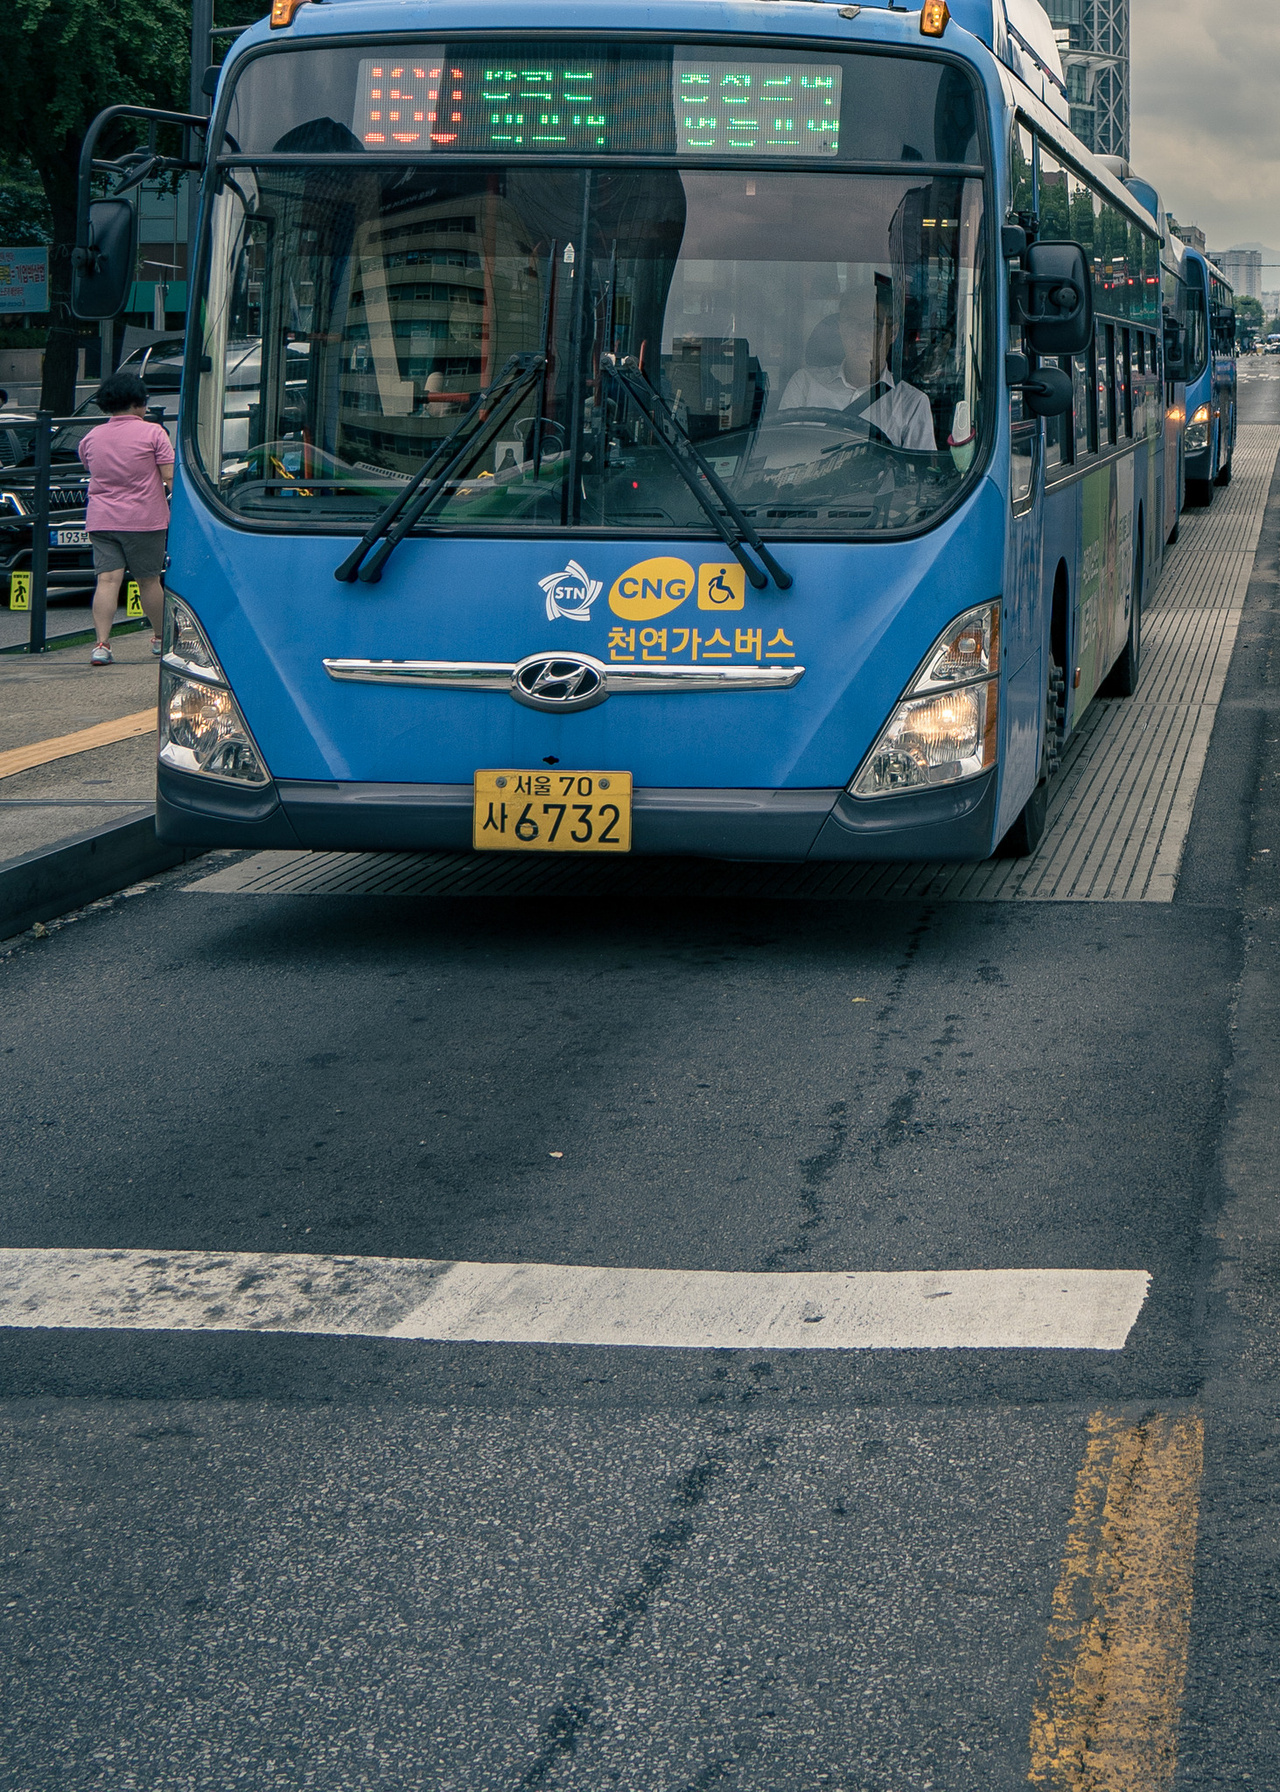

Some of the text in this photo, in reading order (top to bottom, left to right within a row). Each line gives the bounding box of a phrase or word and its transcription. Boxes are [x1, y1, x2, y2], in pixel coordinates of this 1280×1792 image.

[555, 587, 586, 600] STN
[618, 577, 686, 600] CNG
[608, 627, 796, 661] 천연가스버스
[514, 775, 593, 796] 서울 70
